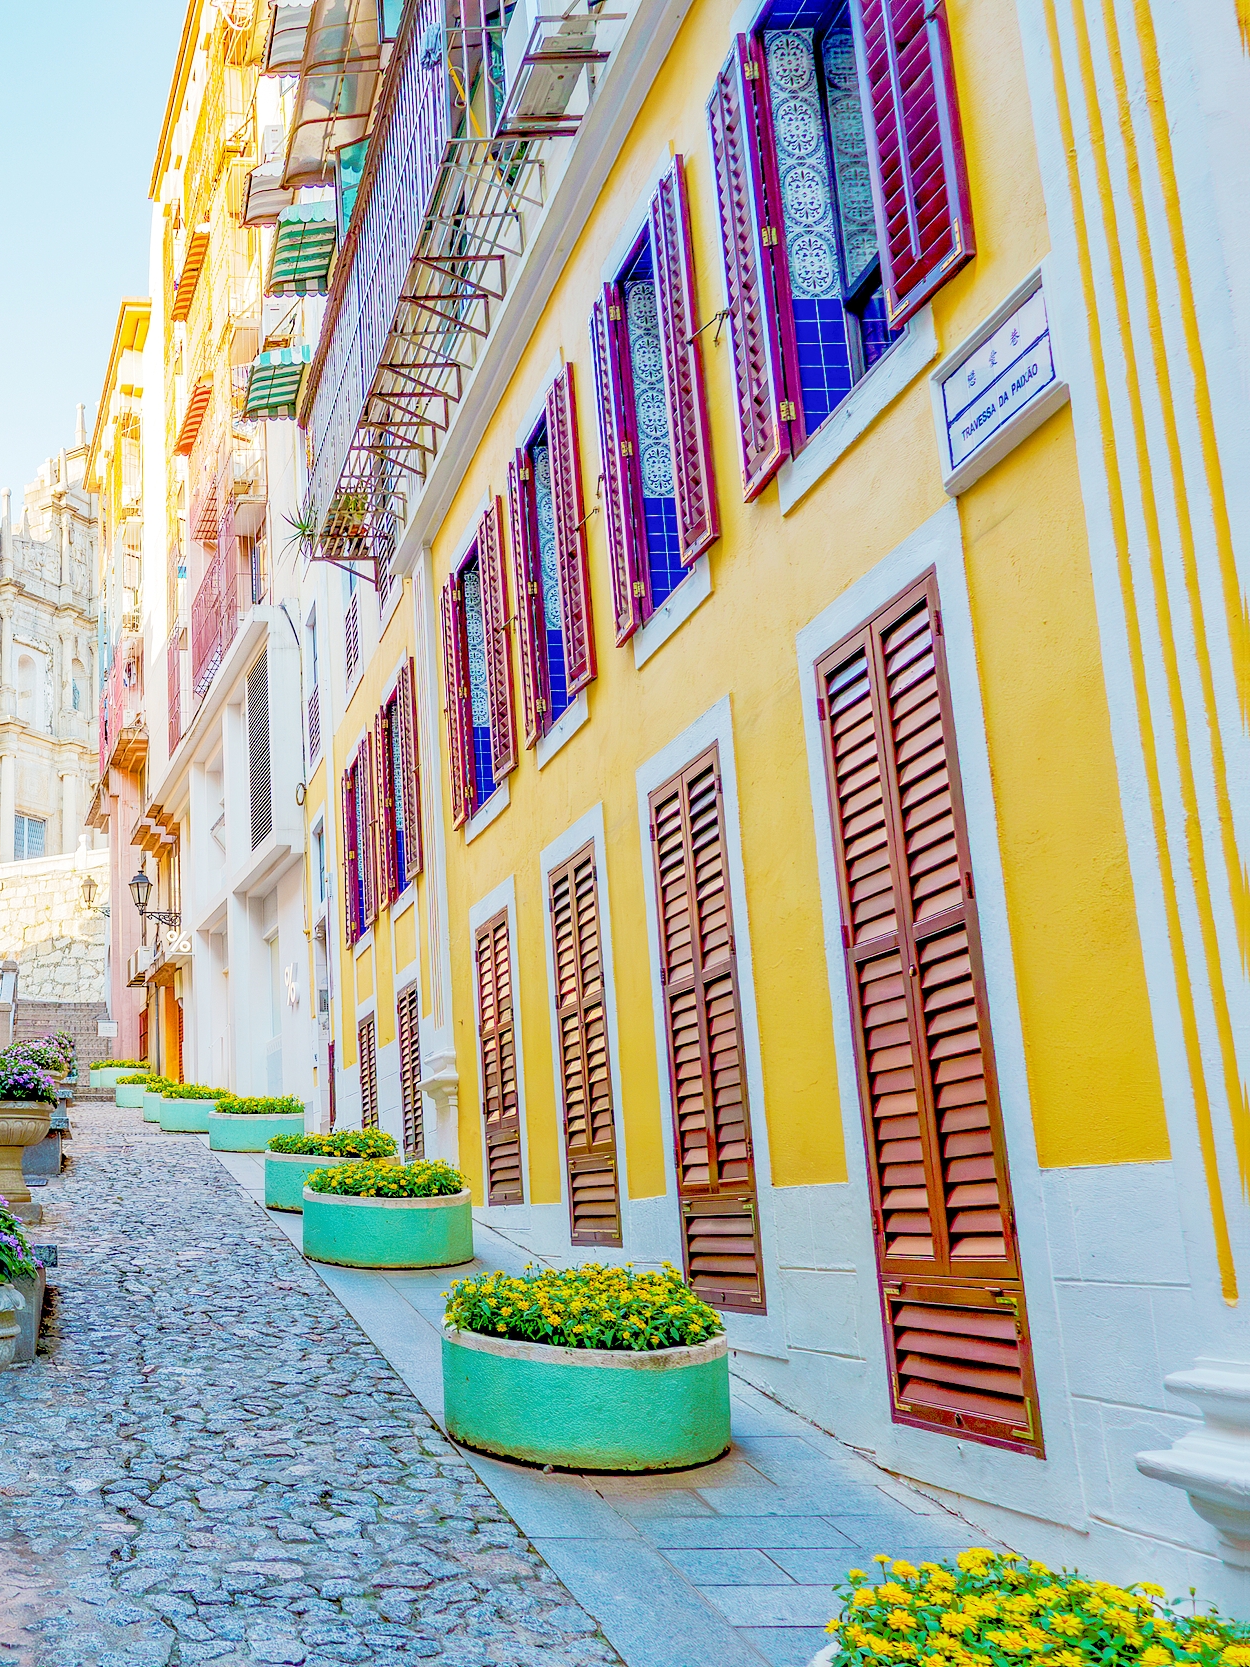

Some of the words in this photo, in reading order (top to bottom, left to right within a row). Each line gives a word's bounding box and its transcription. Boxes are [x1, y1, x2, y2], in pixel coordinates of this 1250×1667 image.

[961, 403, 996, 441] TRAVESSA
[998, 391, 1009, 408] DA
[1010, 362, 1038, 396] PAIXÃO
